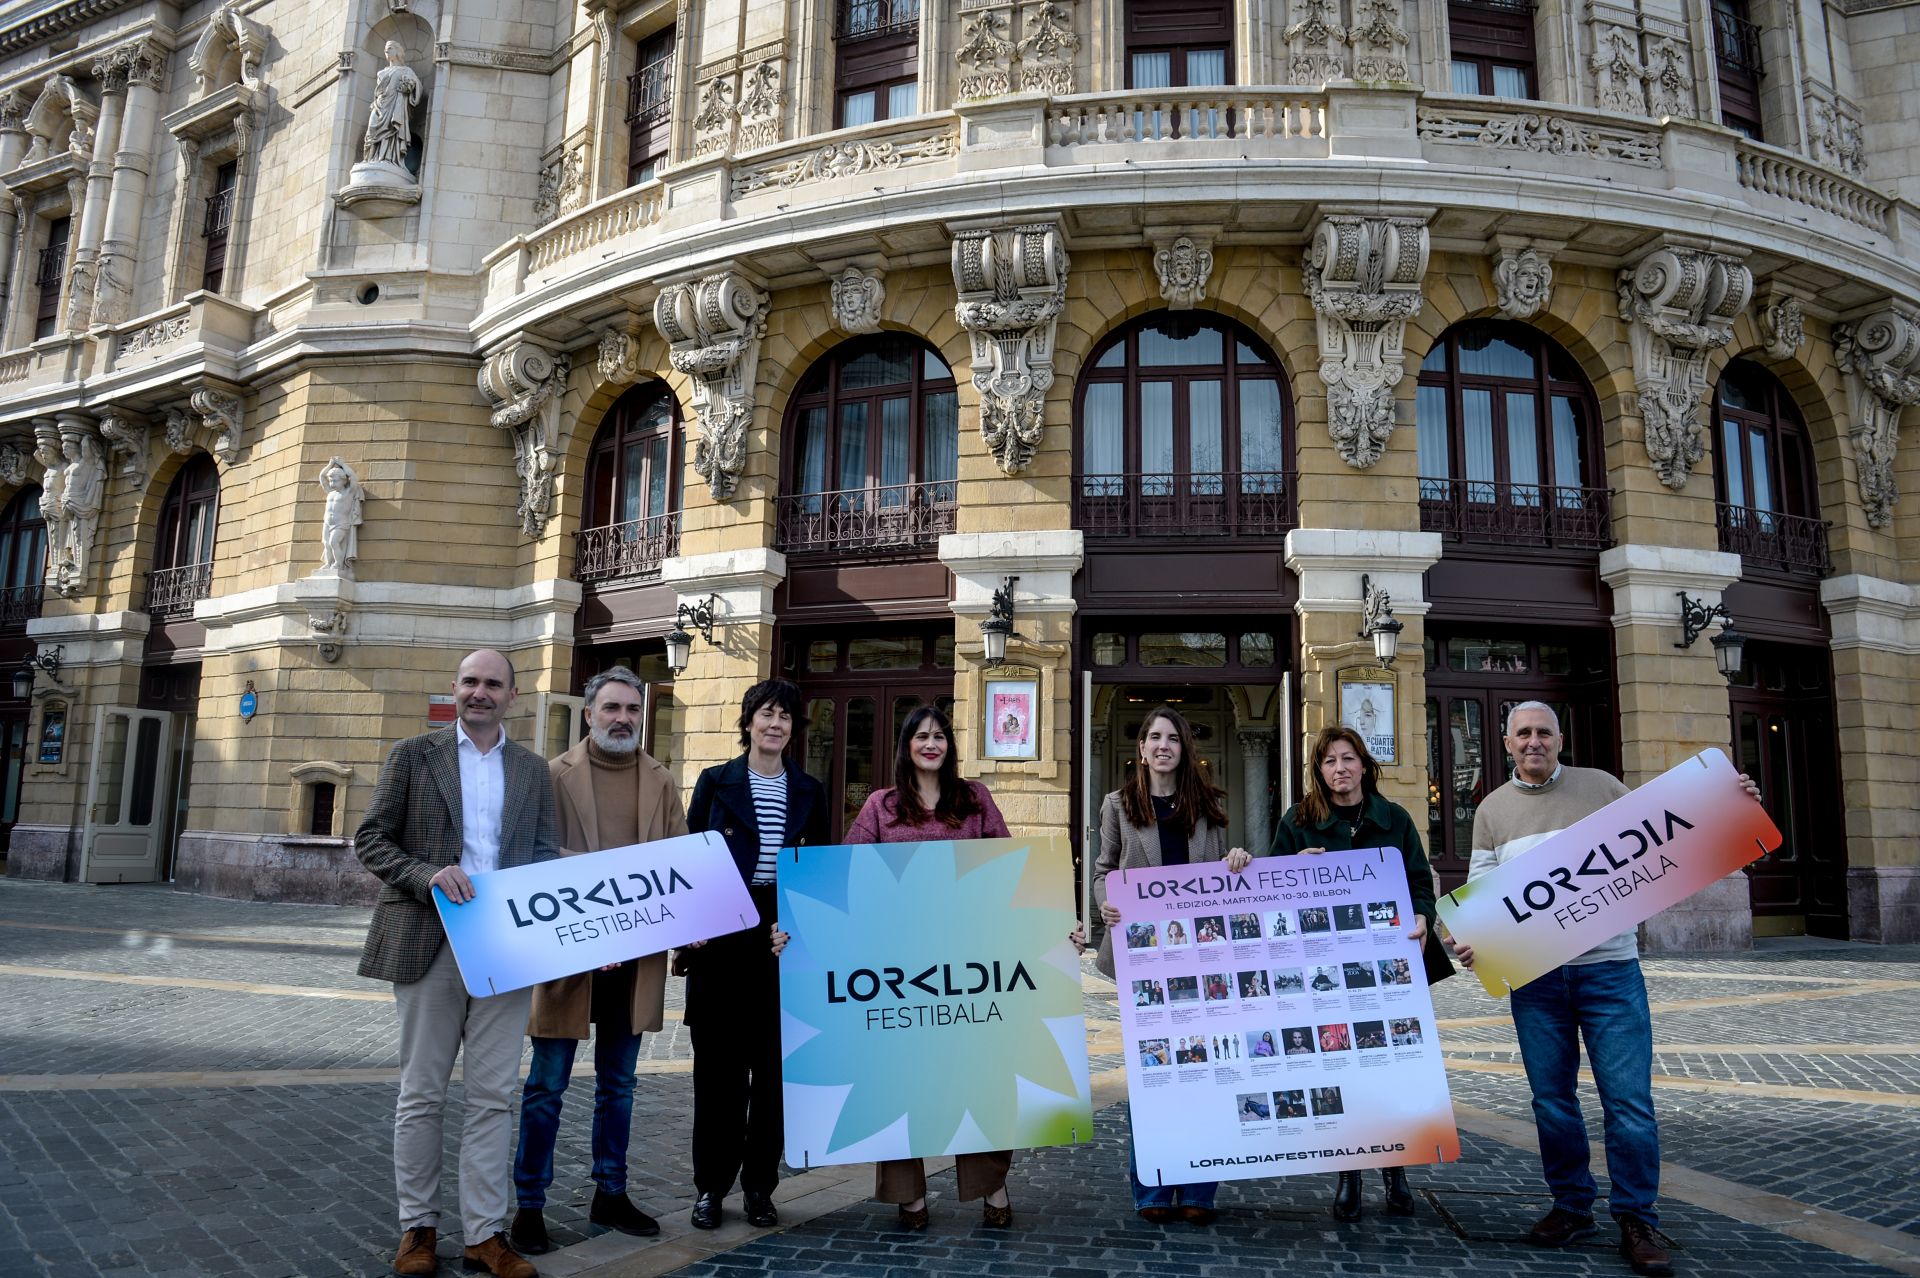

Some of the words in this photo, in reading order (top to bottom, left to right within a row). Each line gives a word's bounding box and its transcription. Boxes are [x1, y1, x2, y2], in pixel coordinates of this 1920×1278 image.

[1258, 863, 1377, 889] FESTIBALA
[1165, 903, 1176, 911] 11.
[1177, 900, 1221, 910] EDIZIOA.
[1222, 893, 1280, 905] MARTXOAK
[1281, 891, 1312, 901] 10-30.
[1313, 888, 1351, 898] BILBON
[1553, 854, 1679, 930] FESTIBALA
[555, 903, 675, 946] FESTIBALA
[866, 1001, 1003, 1031] FESTIBALA
[1189, 1143, 1406, 1169] LORALDIAFESTIBALA.EUS
